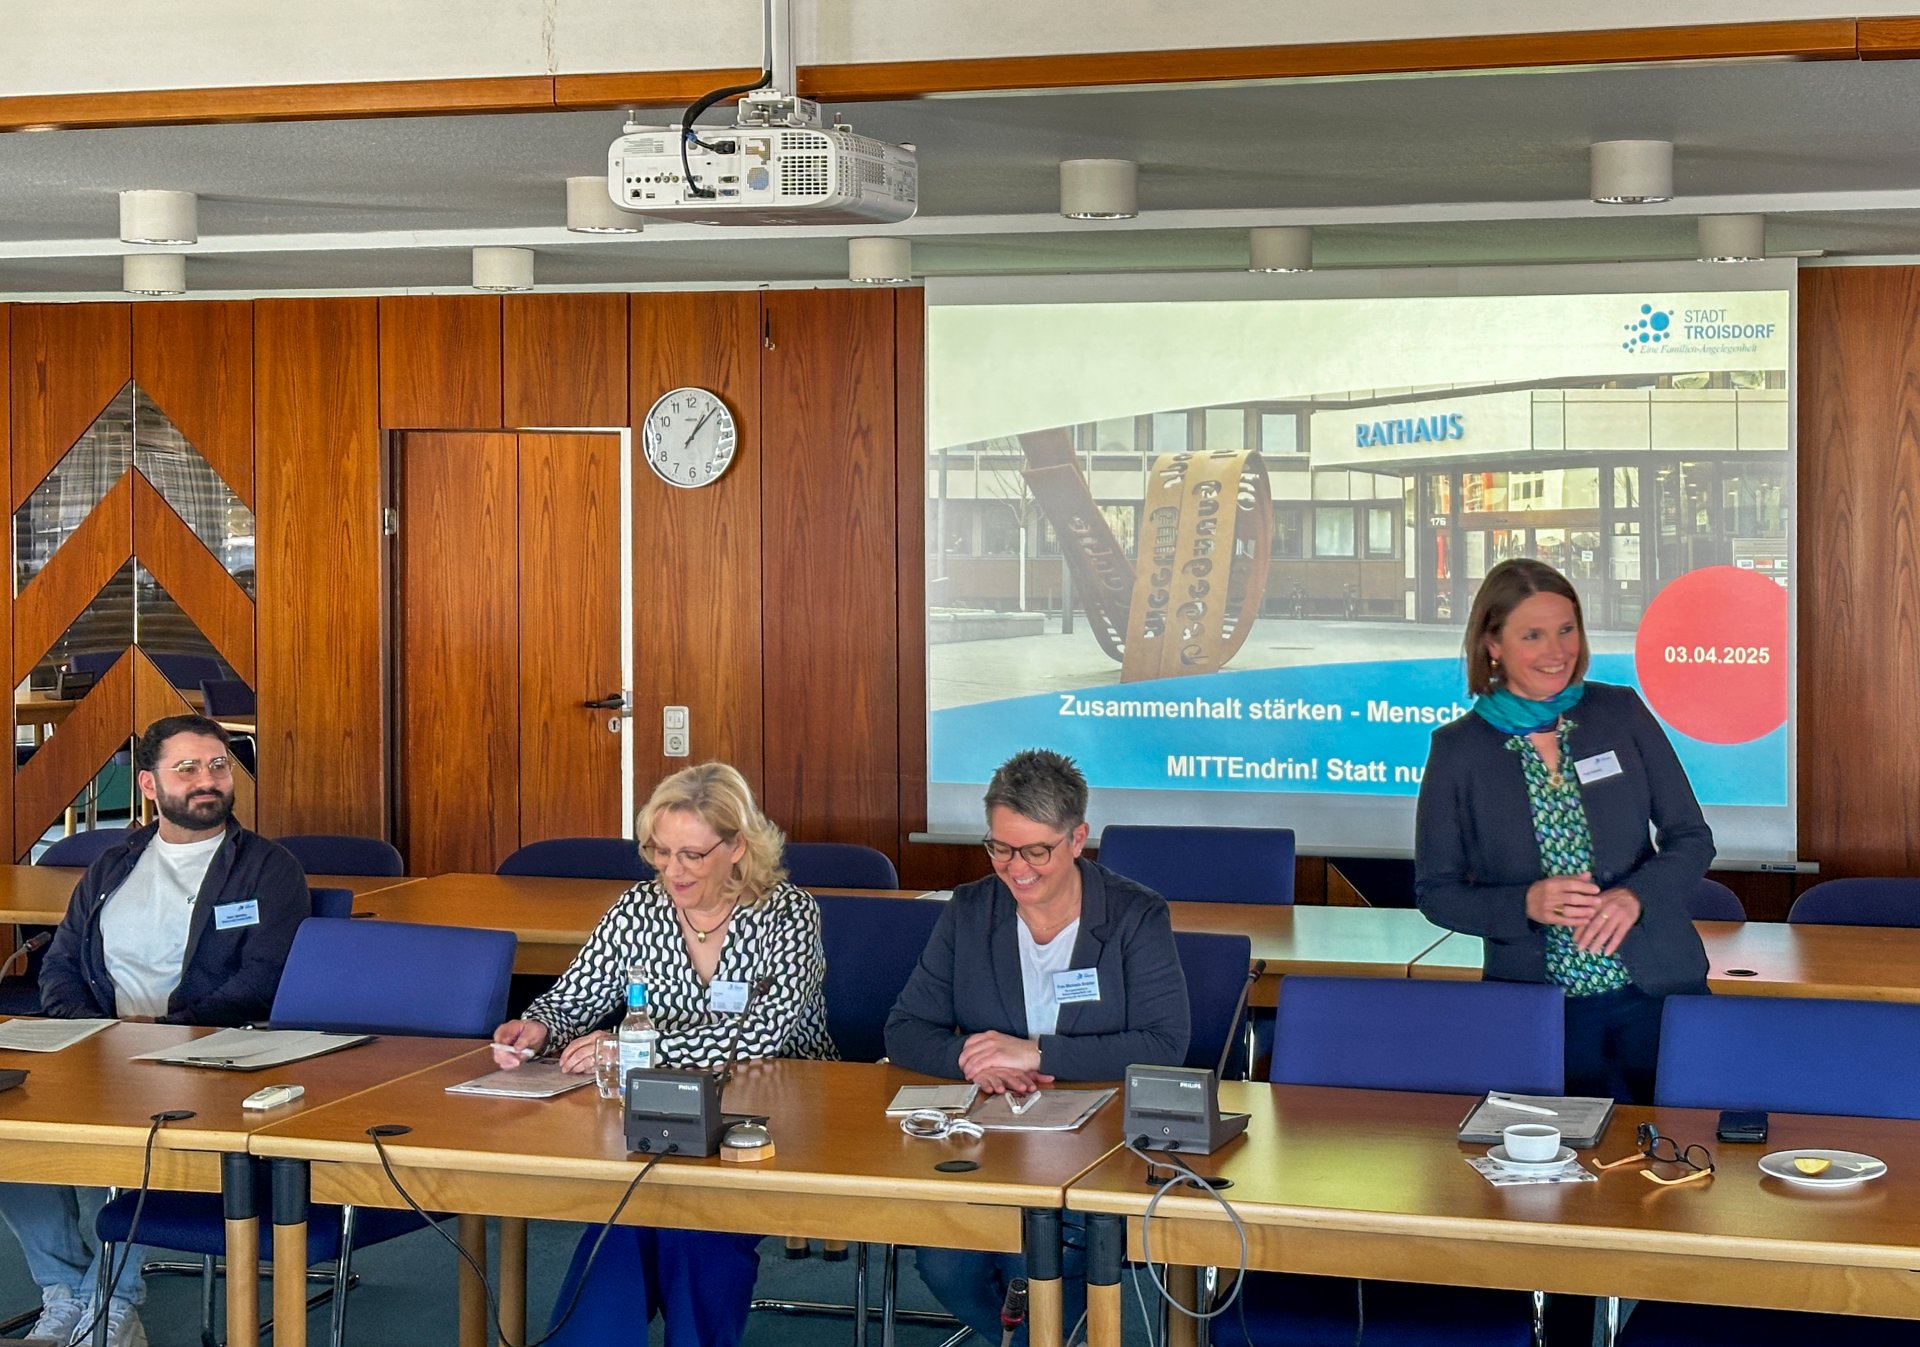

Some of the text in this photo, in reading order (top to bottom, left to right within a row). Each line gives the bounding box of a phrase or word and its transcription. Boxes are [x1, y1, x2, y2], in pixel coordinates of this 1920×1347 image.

[1684, 309, 1727, 324] STADT
[1684, 324, 1775, 339] TROISDORF
[1639, 345, 1660, 354] Eine
[672, 403, 680, 413] 11
[685, 397, 697, 408] 12
[706, 402, 710, 412] 1
[660, 416, 671, 427] 10
[1355, 413, 1465, 447] RATHAUS
[655, 433, 662, 444] 9
[660, 451, 667, 462] 8
[673, 463, 680, 474] 7
[689, 467, 696, 478] 6
[705, 462, 712, 473] 5
[1430, 518, 1447, 526] 176
[1664, 646, 1770, 664] 03.04.2025
[1059, 694, 1242, 719] Zusammenhalt
[1249, 698, 1342, 721] stärken
[1167, 755, 1318, 780] MITTEndrin!
[1327, 758, 1387, 783] Statt
